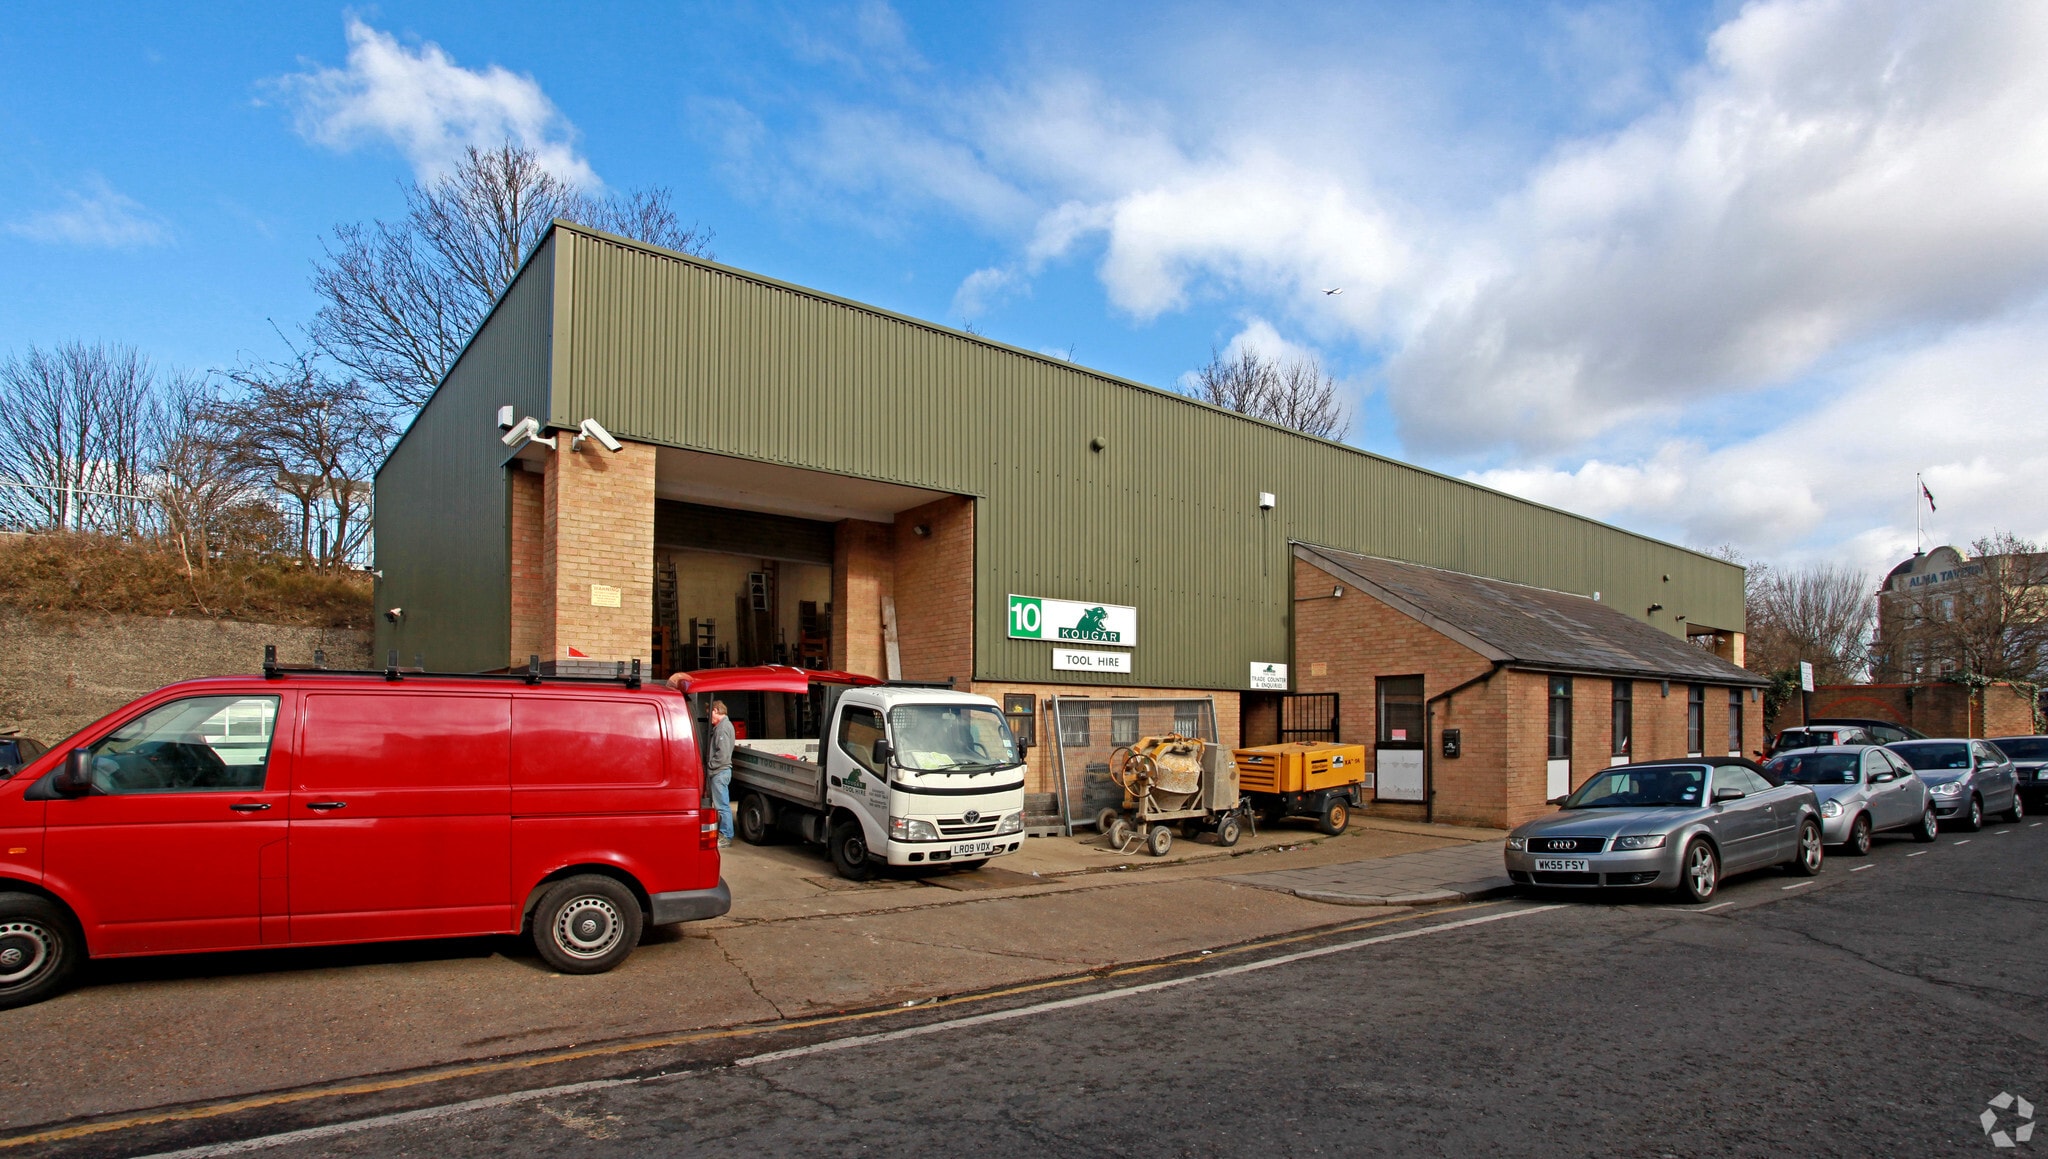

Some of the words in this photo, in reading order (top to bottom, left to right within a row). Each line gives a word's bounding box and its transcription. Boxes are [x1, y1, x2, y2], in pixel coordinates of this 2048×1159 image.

[1909, 573, 1938, 587] ALMA
[1939, 564, 1984, 582] TAVERN
[1010, 602, 1041, 632] 10
[1062, 629, 1117, 642] KOUGAR
[1065, 655, 1092, 666] TOOL
[1098, 657, 1119, 667] HIRE
[760, 758, 776, 768] TOOL
[779, 762, 794, 774] HIRE
[954, 844, 975, 854] LR09
[976, 842, 991, 851] VDX
[1538, 860, 1563, 870] WK55
[1564, 860, 1585, 870] FSY
